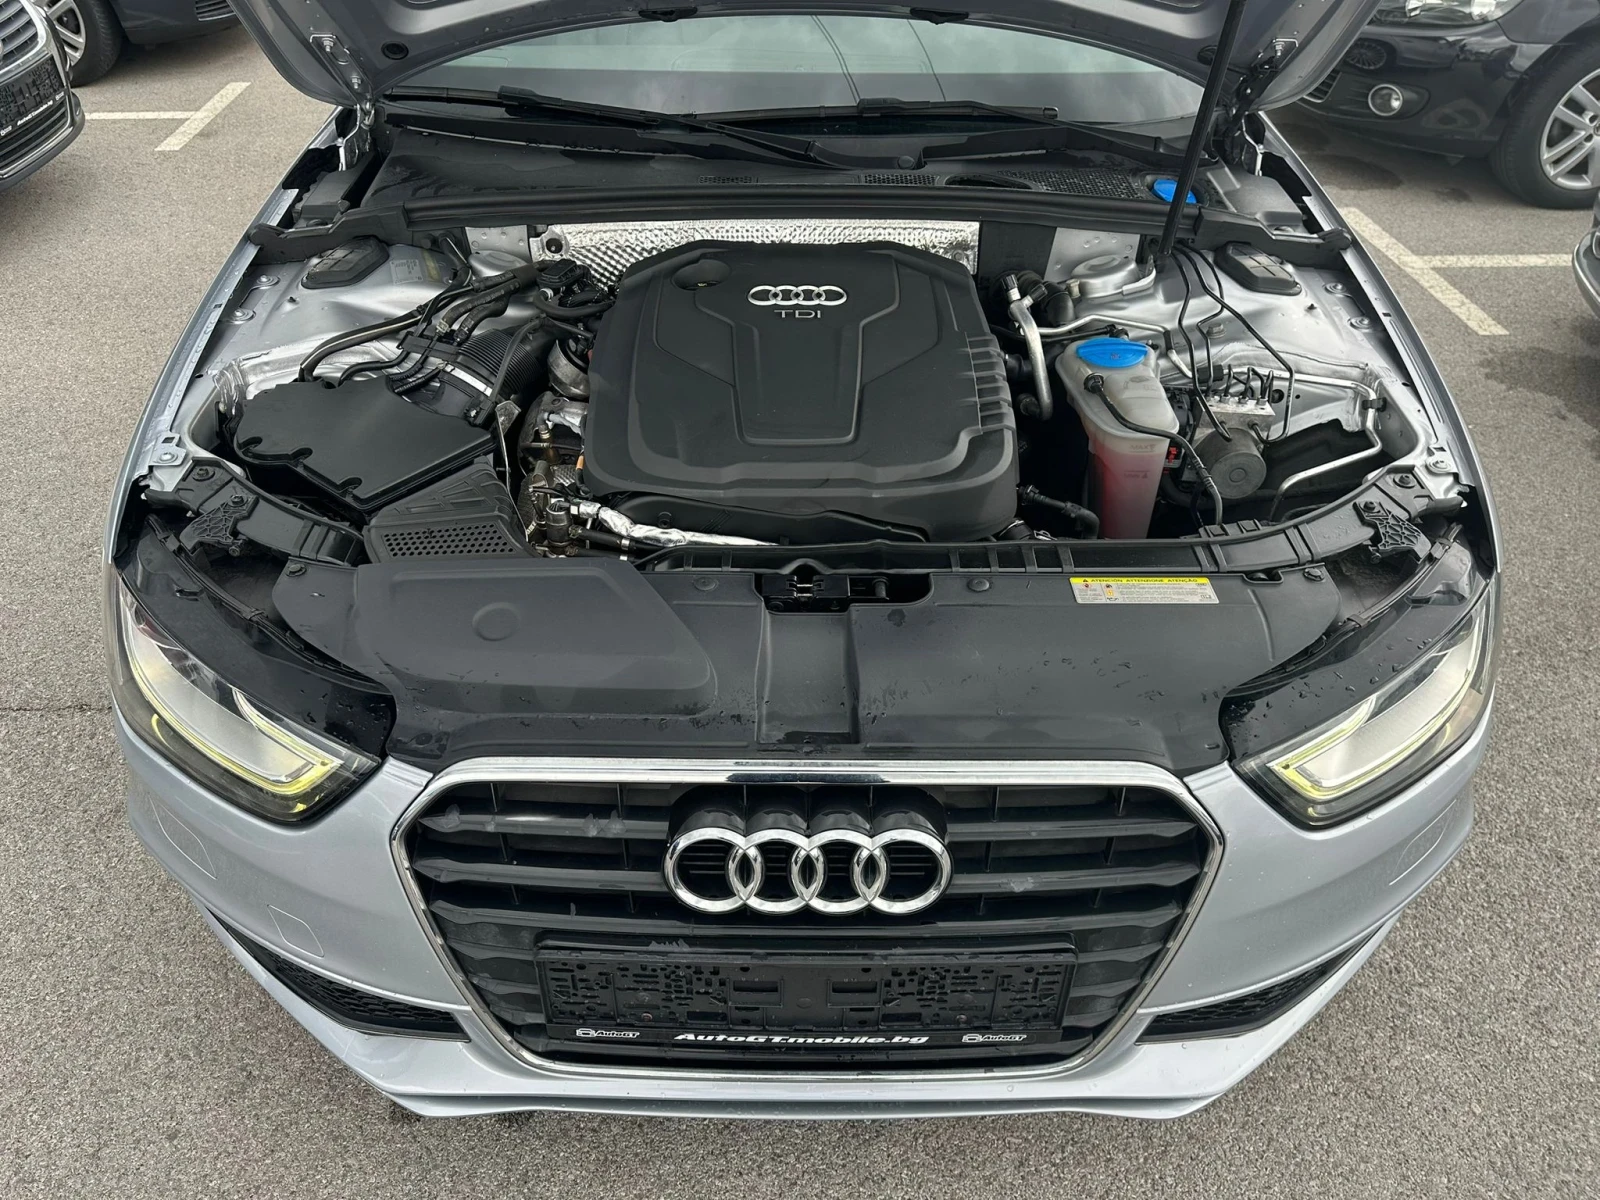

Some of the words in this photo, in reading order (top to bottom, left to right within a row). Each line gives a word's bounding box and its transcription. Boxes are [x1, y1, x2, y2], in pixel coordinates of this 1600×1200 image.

[774, 310, 821, 319] TDI
[595, 1030, 640, 1039] AutoGT
[982, 1034, 1028, 1042] AutoGT
